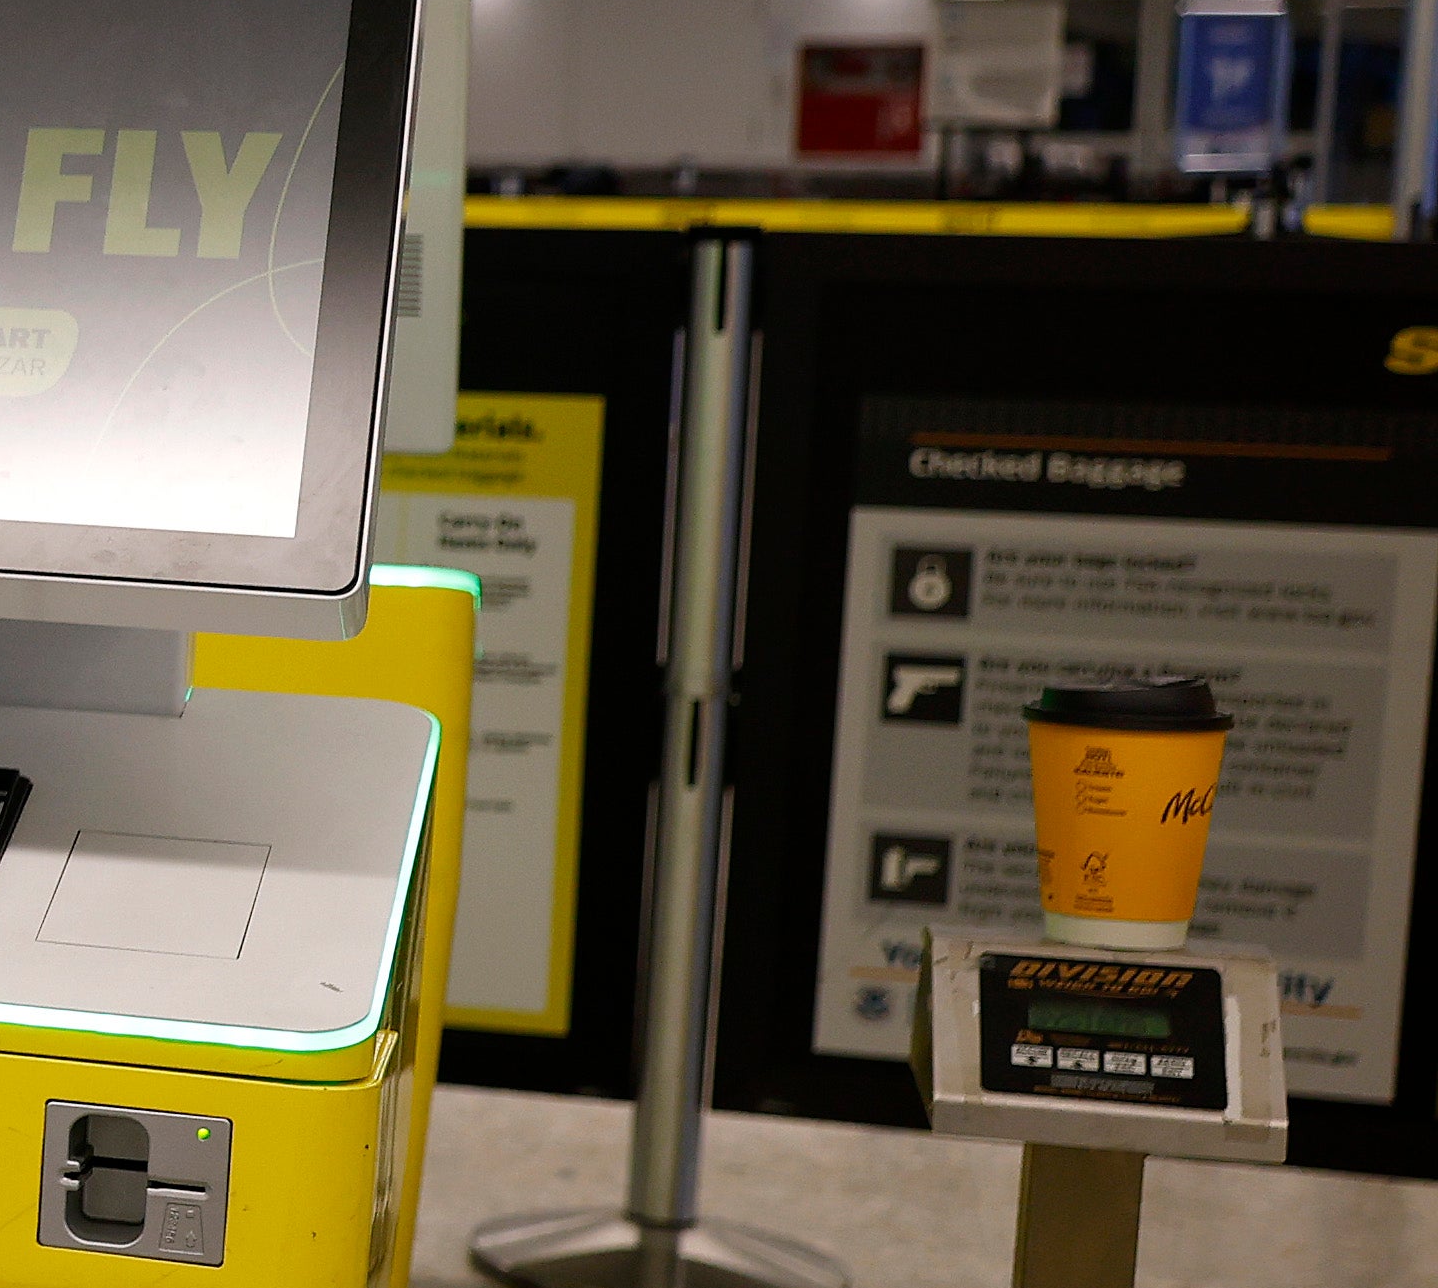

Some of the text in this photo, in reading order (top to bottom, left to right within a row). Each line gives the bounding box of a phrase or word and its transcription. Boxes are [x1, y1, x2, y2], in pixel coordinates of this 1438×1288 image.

[11, 127, 283, 260] FLY
[906, 445, 1187, 491] Checked Baggage
